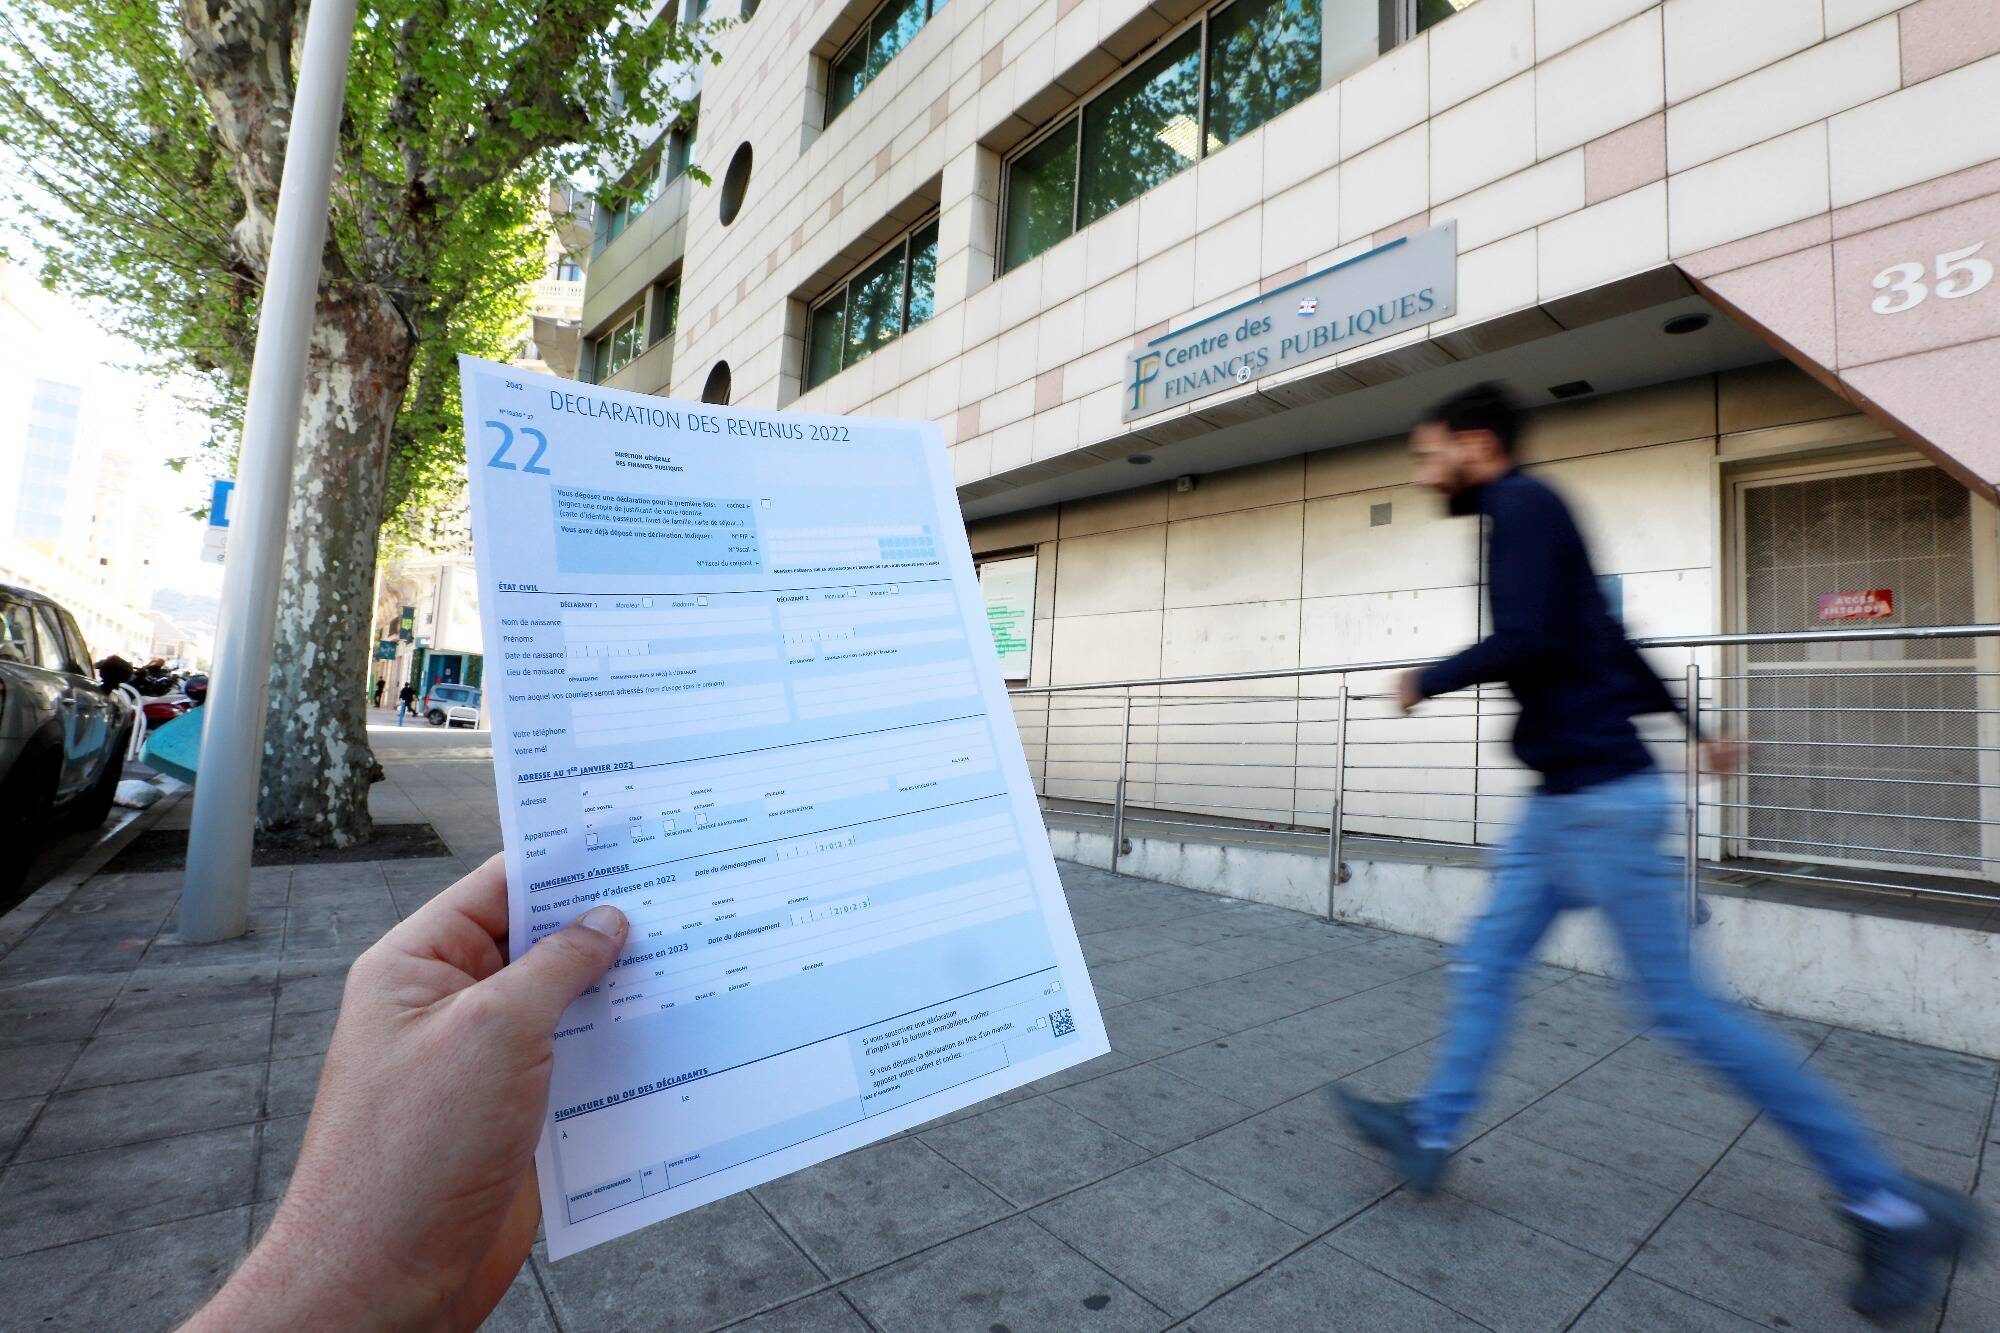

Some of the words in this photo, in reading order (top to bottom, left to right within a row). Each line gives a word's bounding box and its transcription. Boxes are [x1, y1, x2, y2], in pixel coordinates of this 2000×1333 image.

[1871, 240, 1994, 315] 35
[1164, 330, 1229, 368] Centre
[1235, 315, 1272, 342] des
[1164, 347, 1269, 400] FINANCES
[1280, 287, 1435, 360] PUBLIQUES
[505, 380, 524, 391] 2042
[550, 390, 680, 430] DECLARATION
[688, 413, 720, 434] DES
[727, 418, 803, 440] REVENUS
[808, 424, 851, 442] 2022
[485, 420, 551, 476] 22
[557, 489, 574, 498] Vous
[574, 491, 601, 501] déposez
[616, 495, 651, 505] déclaration
[651, 499, 666, 507] pour
[560, 525, 577, 533] Vous
[609, 529, 633, 538] déposé
[498, 581, 517, 591] ÉTAT
[519, 584, 539, 592] CIVIL
[501, 618, 519, 626] Nom
[520, 618, 529, 626] de
[530, 618, 561, 626] naissance
[503, 635, 534, 643] Prénoms
[504, 651, 521, 660] Date
[522, 651, 531, 659] de
[532, 650, 564, 659] naissance
[506, 668, 521, 676] Lieu
[522, 668, 531, 676] de
[533, 667, 566, 675] naissance
[509, 693, 526, 702] Nom
[527, 692, 551, 703] auquel
[552, 692, 564, 700] vos
[565, 690, 593, 700] courriers
[594, 689, 615, 697] seront
[616, 686, 644, 696] adressés
[512, 730, 531, 739] Votre
[532, 727, 567, 738] téléphone
[514, 747, 533, 756] Votre
[517, 770, 552, 782] ADRESSE
[553, 769, 564, 777] AU
[579, 763, 611, 775] JANVIER
[613, 761, 634, 770] 2023
[520, 797, 547, 807] Adresse
[524, 826, 568, 843] Appartement
[526, 848, 547, 859] Statut
[694, 867, 710, 877] Date
[710, 865, 719, 873] du
[719, 856, 767, 872] déménagement
[529, 872, 586, 891] CHANGEMENTS
[587, 863, 630, 879] D'ADRESSE
[531, 903, 551, 913] Vous
[553, 899, 571, 909] avez
[571, 890, 601, 904] changé
[602, 882, 642, 898] d'adresse
[643, 880, 654, 889] en
[656, 874, 677, 886] 2022
[531, 921, 561, 933] Adresse
[707, 936, 723, 945] Date
[723, 933, 732, 941] du
[733, 921, 780, 938] déménagement
[613, 951, 654, 968] d'adresse
[655, 948, 666, 958] en
[667, 943, 689, 955] 2023
[553, 1022, 595, 1040] partement
[869, 1034, 884, 1043] vous
[914, 1020, 926, 1029] une
[876, 1064, 892, 1074] vous
[554, 1097, 604, 1120] SIGNATURE
[606, 1093, 620, 1104] DU
[622, 1088, 636, 1099] OU
[637, 1083, 654, 1095] DES
[656, 1067, 709, 1089] DÉCLARANTS
